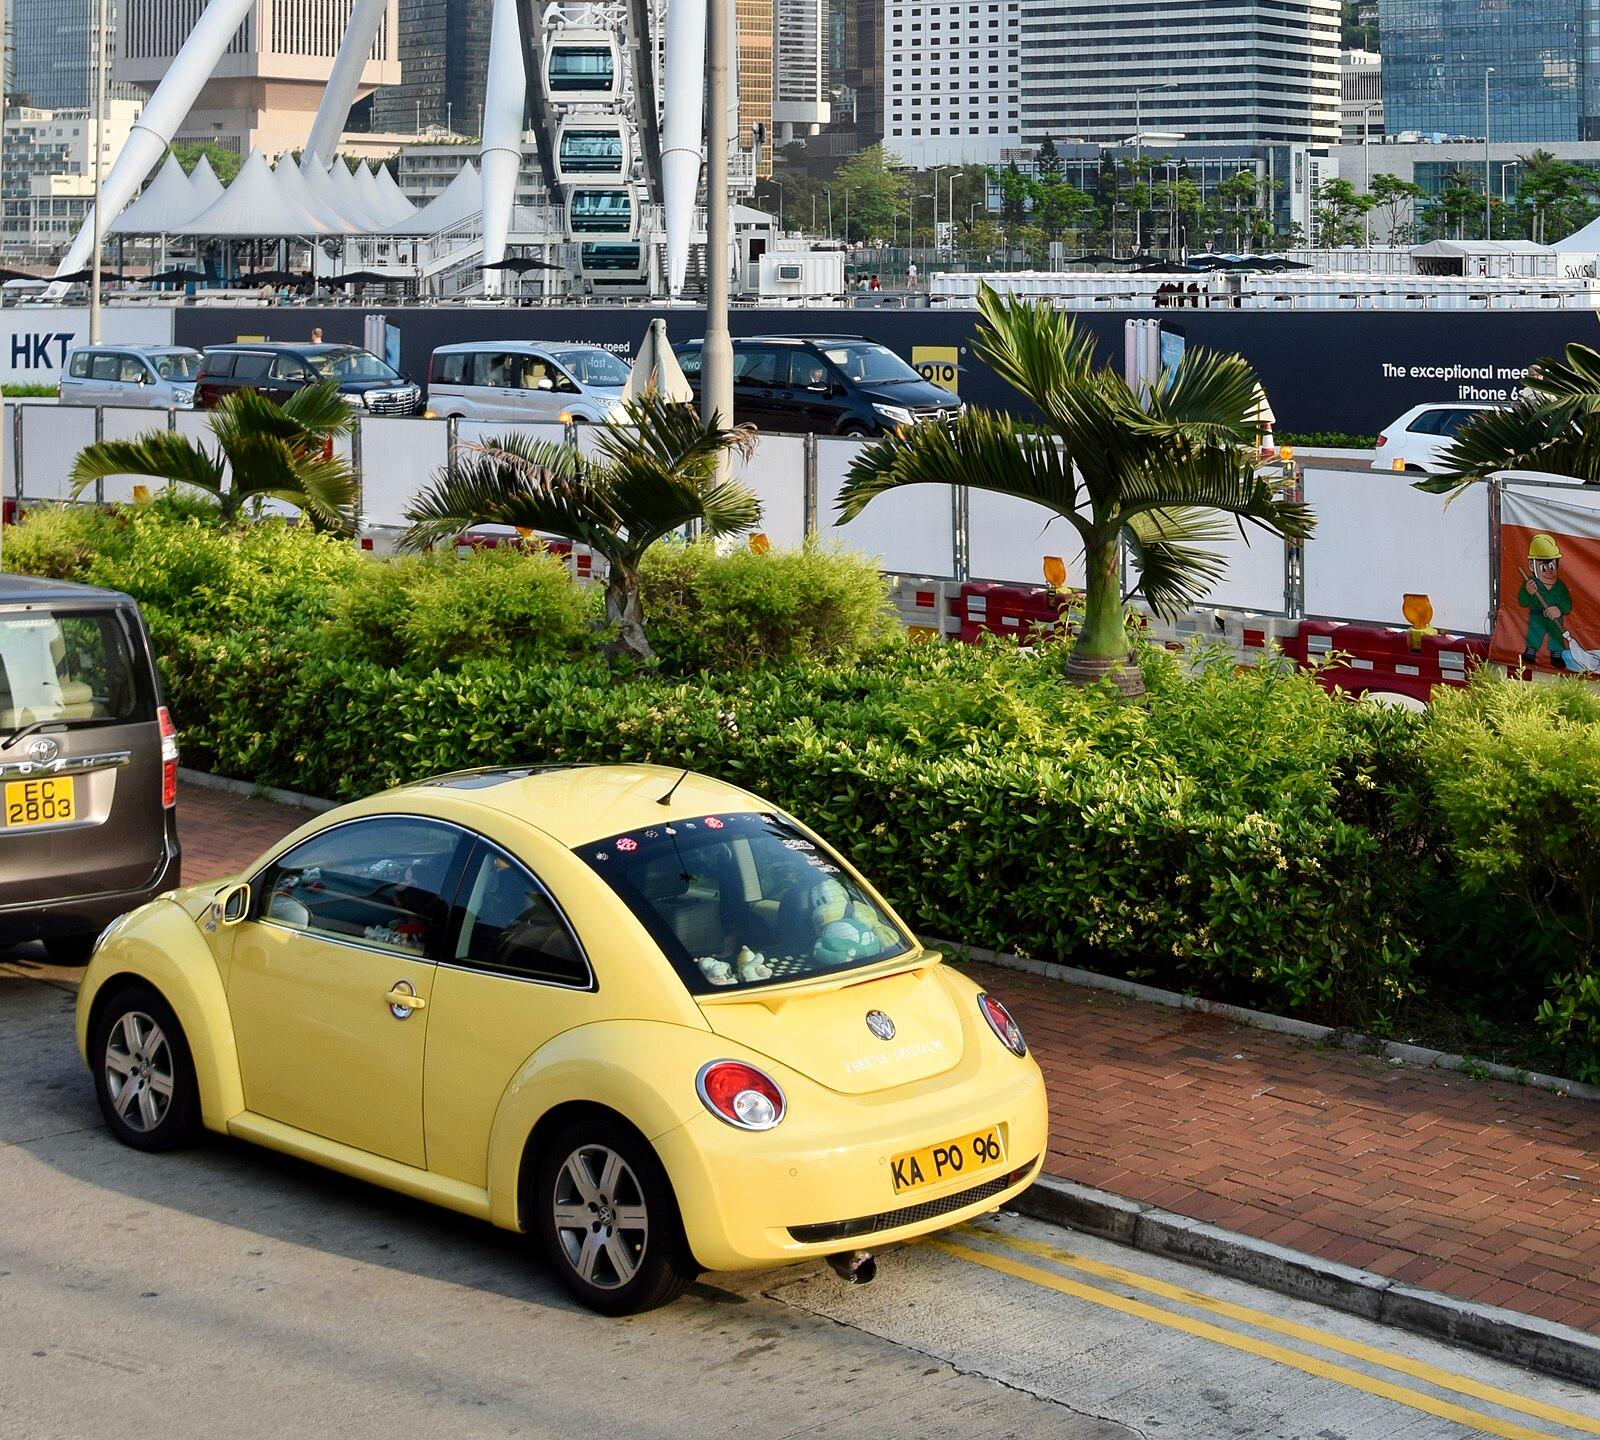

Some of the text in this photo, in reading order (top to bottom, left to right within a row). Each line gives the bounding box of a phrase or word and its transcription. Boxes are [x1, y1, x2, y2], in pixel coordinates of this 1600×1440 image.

[11, 333, 76, 369] HKT
[603, 341, 630, 353] speed
[1382, 363, 1529, 381] The exceptional mee
[1458, 385, 1507, 400] iPhone
[25, 781, 55, 802] EC
[10, 799, 71, 823] 2803
[891, 1133, 1000, 1189] KA PO 96
